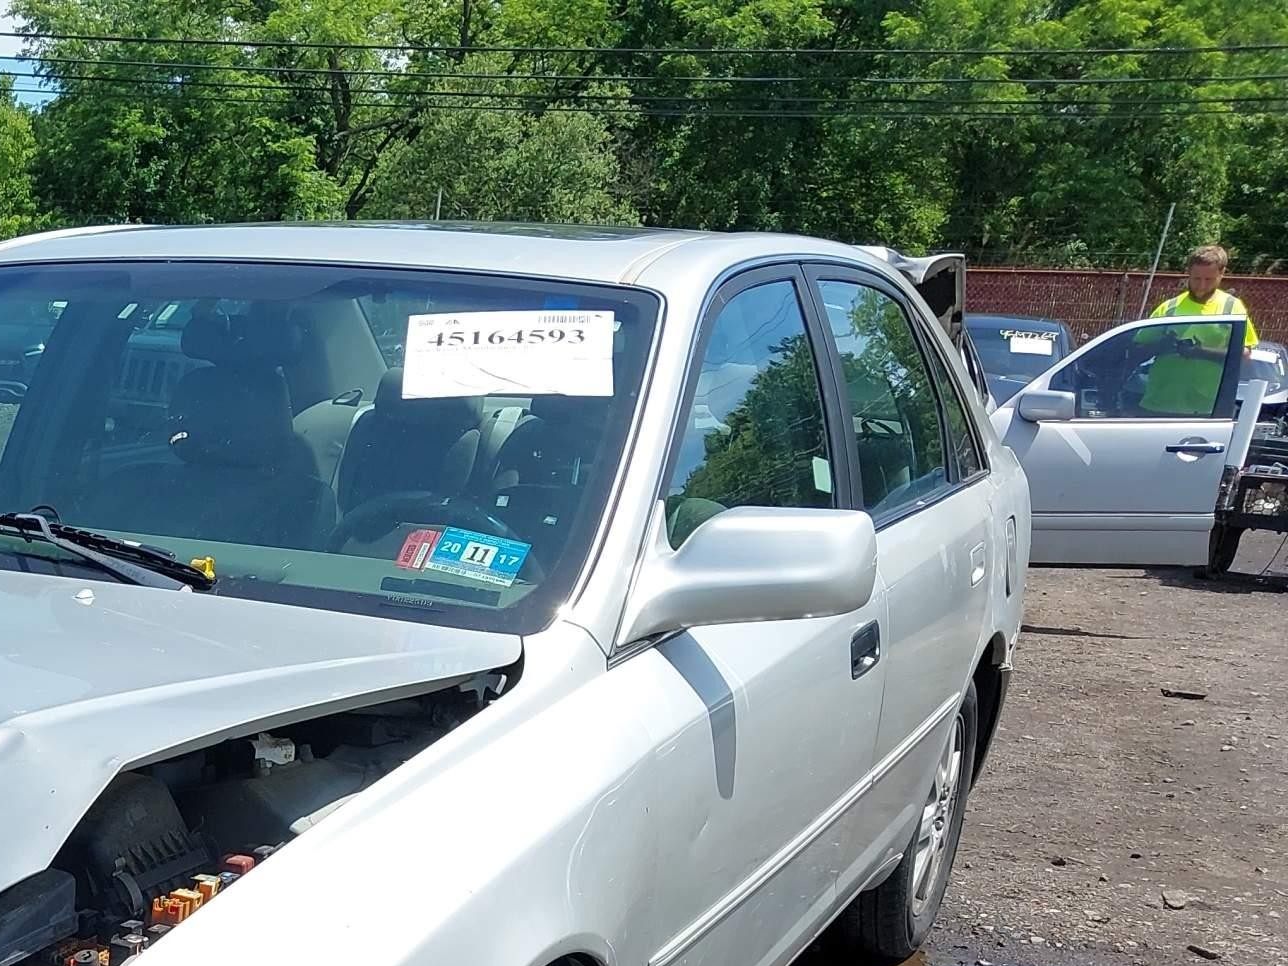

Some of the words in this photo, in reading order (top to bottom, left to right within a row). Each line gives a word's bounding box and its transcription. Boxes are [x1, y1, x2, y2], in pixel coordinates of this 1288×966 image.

[427, 329, 585, 347] 45164593
[440, 541, 462, 554] 20
[467, 546, 491, 564] 11
[499, 554, 520, 566] 17
